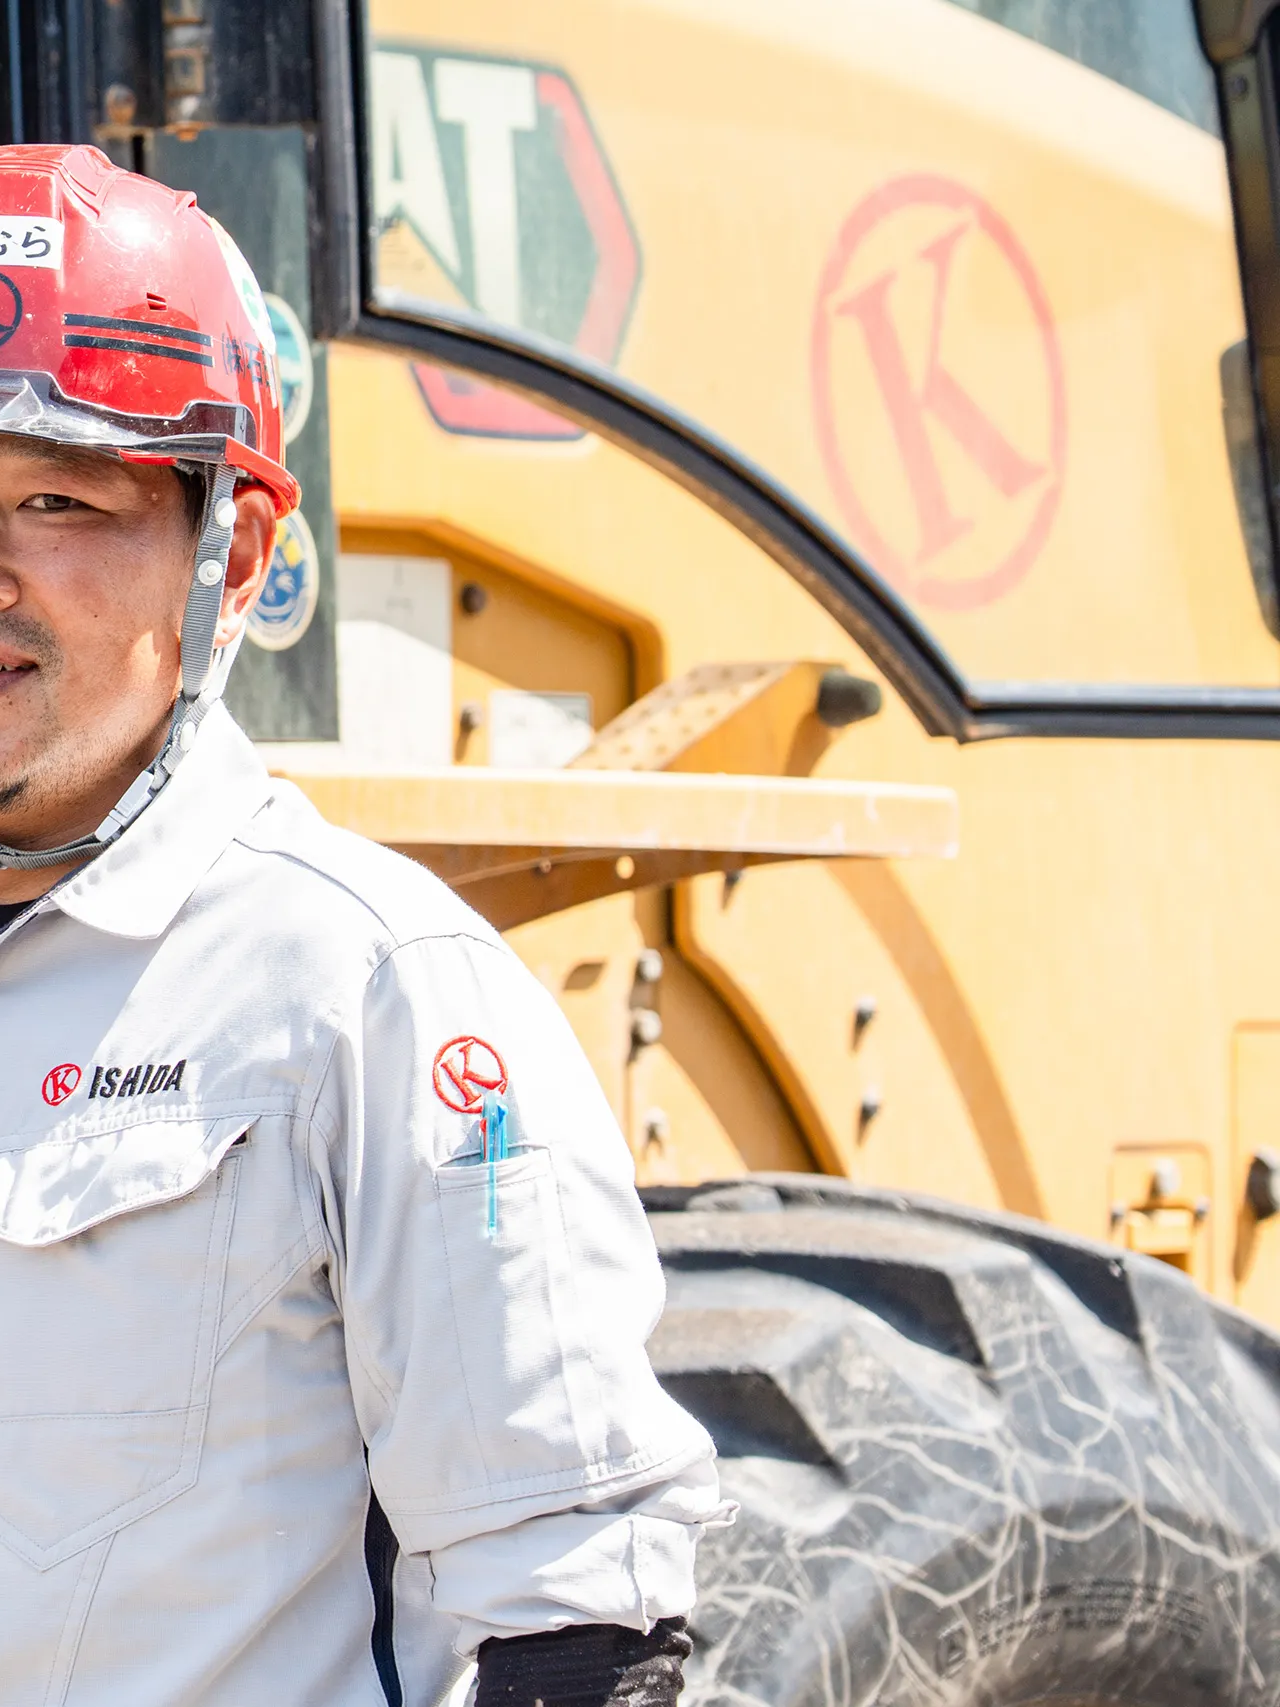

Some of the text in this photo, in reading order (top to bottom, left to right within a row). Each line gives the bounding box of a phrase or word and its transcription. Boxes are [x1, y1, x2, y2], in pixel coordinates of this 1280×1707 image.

[369, 50, 537, 328] AT
[832, 219, 1051, 568] K
[48, 1059, 188, 1102] K ISHIDA
[439, 1040, 505, 1107] K
